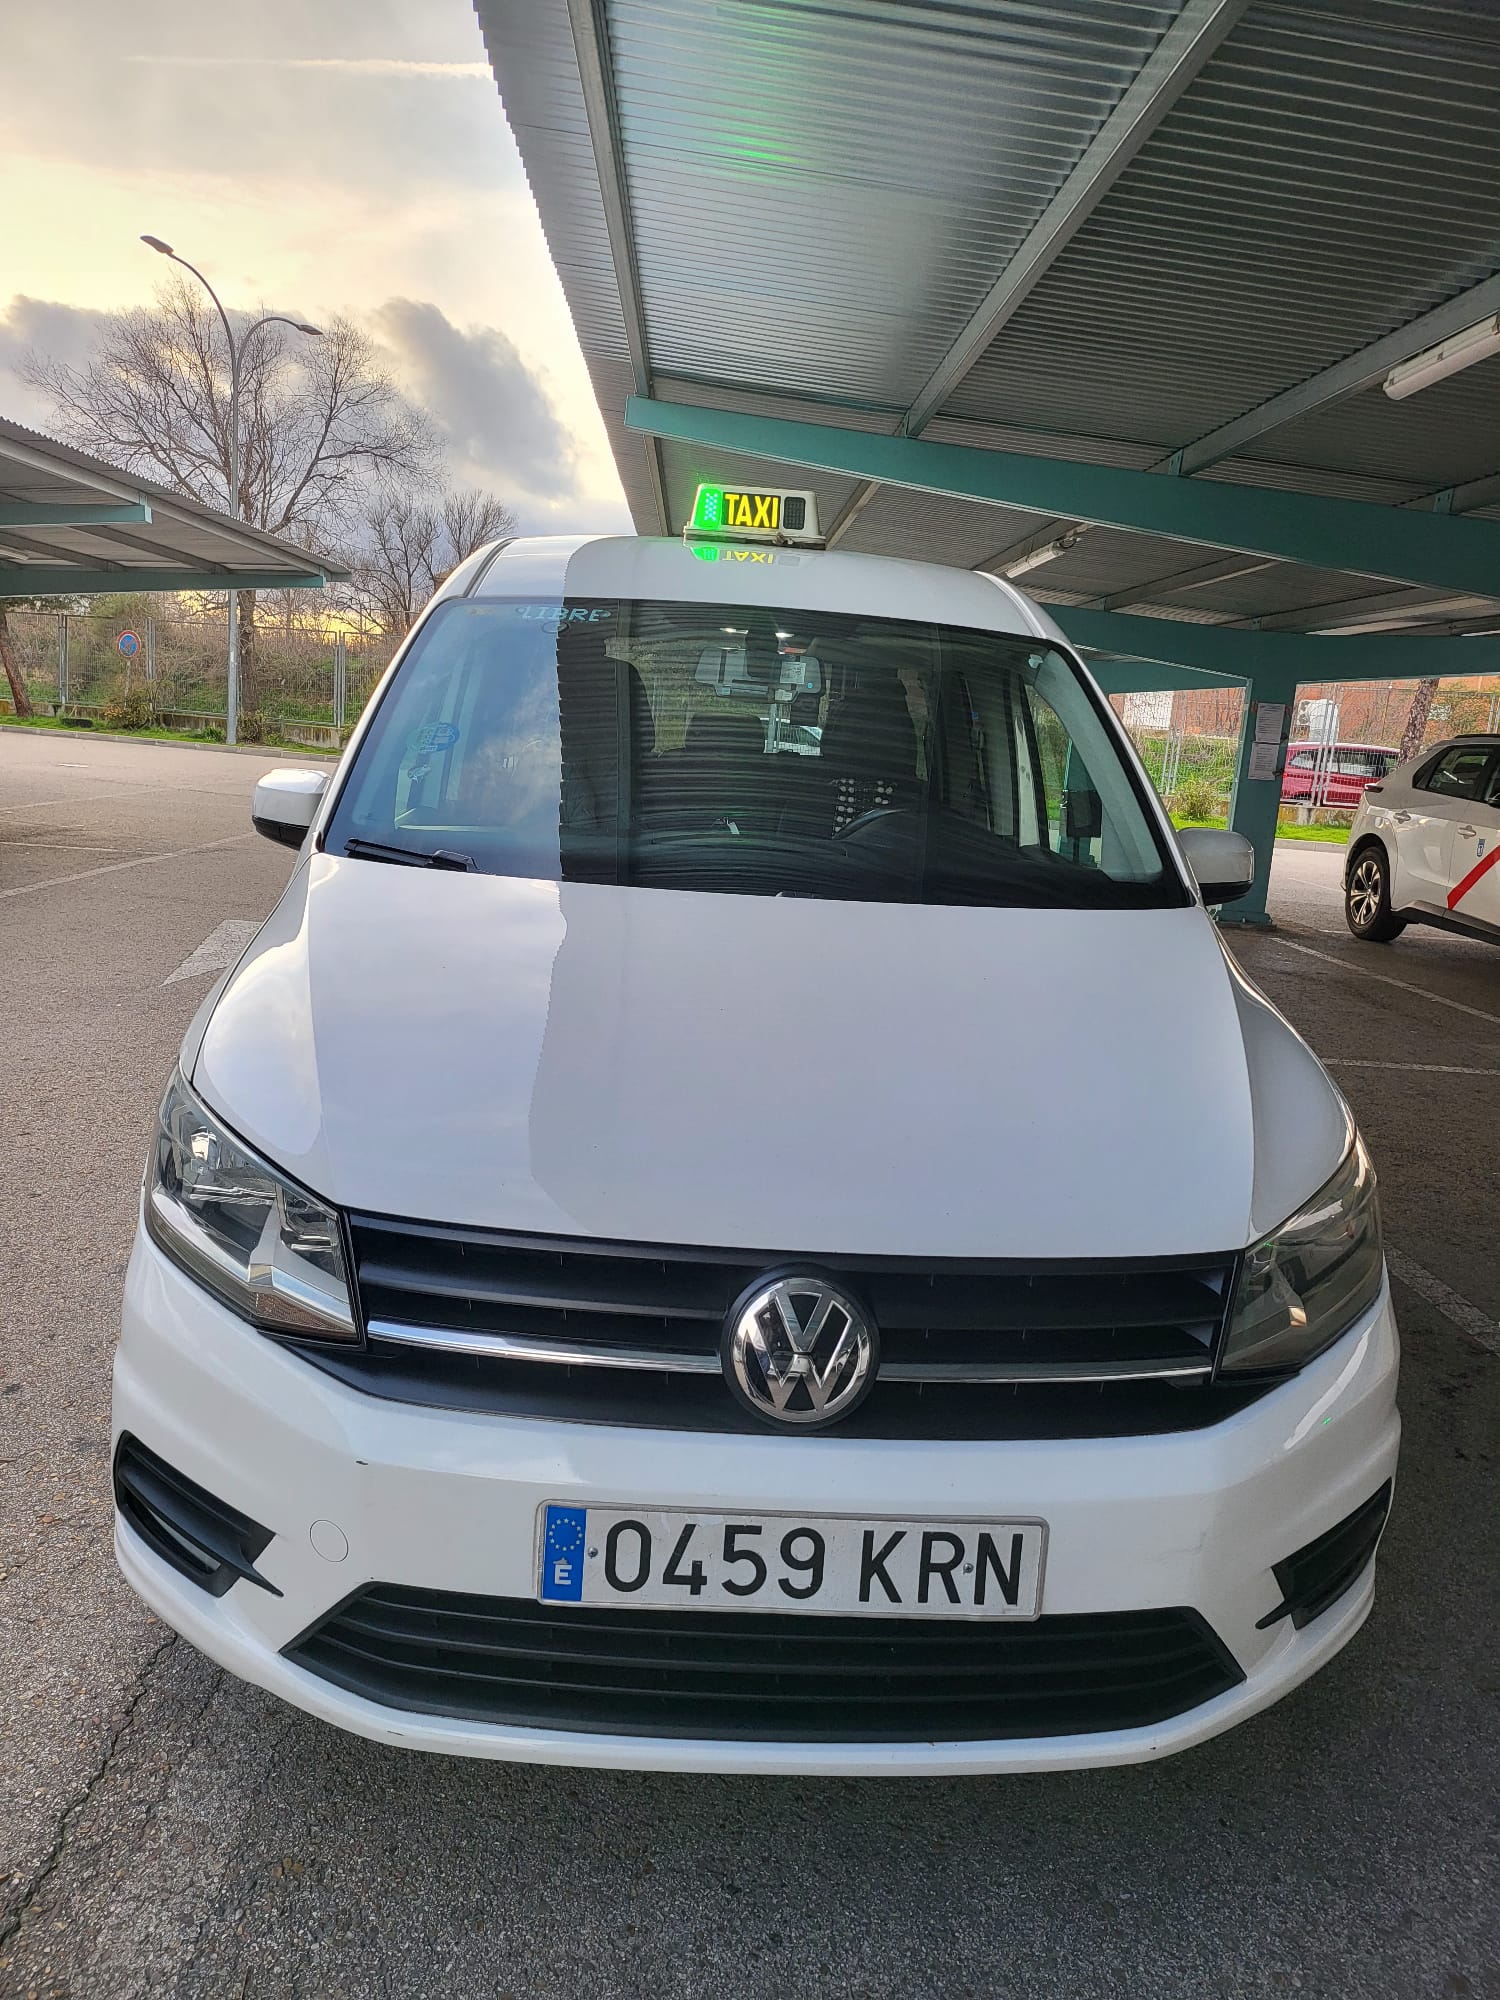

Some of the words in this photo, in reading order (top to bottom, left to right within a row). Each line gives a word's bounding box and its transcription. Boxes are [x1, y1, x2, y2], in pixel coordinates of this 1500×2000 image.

[725, 493, 779, 528] TAXI
[520, 606, 605, 622] LIBRE
[554, 1564, 572, 1585] E
[604, 1519, 826, 1600] 0459
[857, 1529, 1024, 1606] KRN
